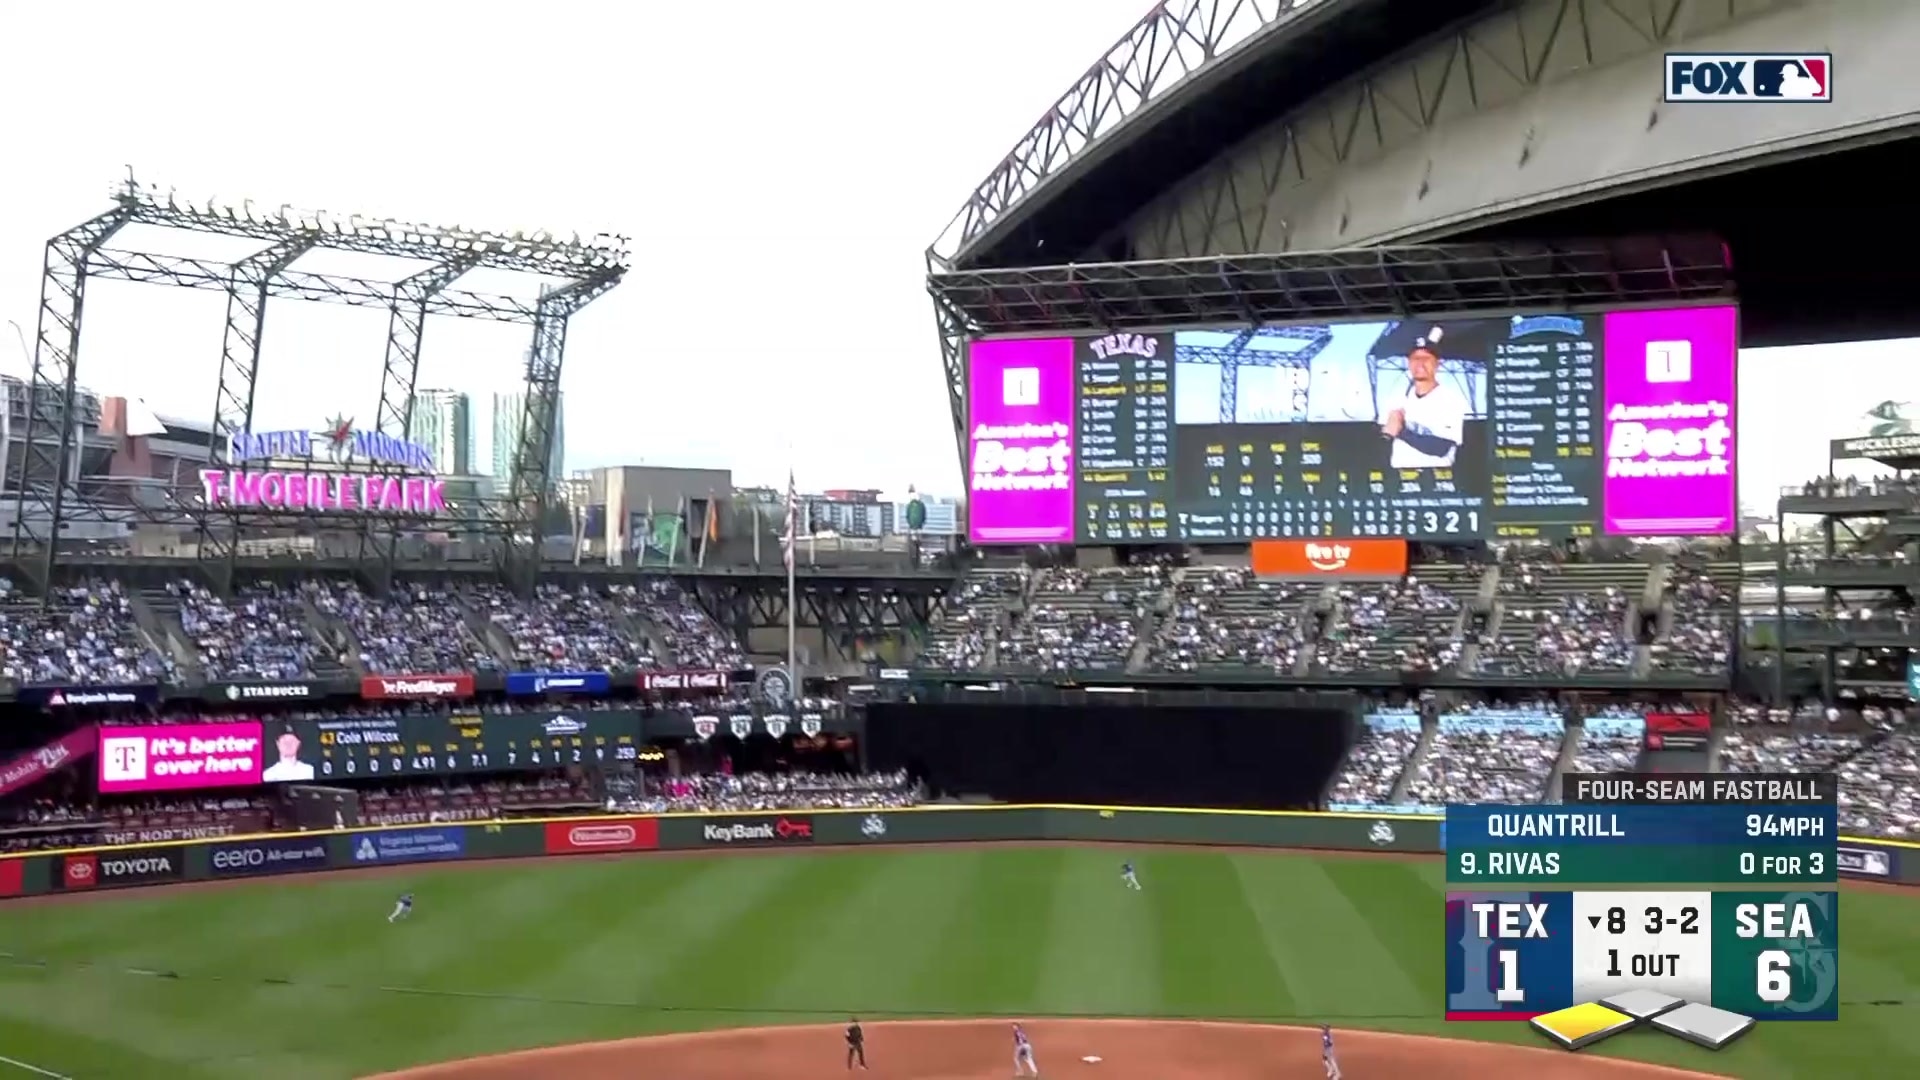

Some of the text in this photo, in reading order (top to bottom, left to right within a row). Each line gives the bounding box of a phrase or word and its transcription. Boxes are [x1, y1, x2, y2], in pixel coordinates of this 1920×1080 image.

[1089, 333, 1158, 359] TEXAS
[229, 430, 311, 462] SEATTLE
[1607, 419, 1731, 458] Best
[355, 428, 437, 475] MARINERS
[973, 439, 1071, 473] Best
[200, 469, 447, 512] T-MOBILE PARK
[1423, 511, 1479, 533] 3 2 1
[652, 675, 681, 688] Coca-Cola
[689, 674, 719, 687] Coca-Cola
[242, 686, 309, 697] STARBUCKS
[151, 736, 258, 756] It's better
[336, 732, 361, 744] Cole
[363, 731, 400, 743] Wilcox
[115, 746, 136, 772] T
[154, 756, 254, 776] over here
[322, 760, 333, 774] 0
[346, 760, 356, 773] 0
[369, 759, 379, 772] 0
[392, 758, 402, 771] 0
[105, 832, 138, 844] THE
[575, 831, 631, 842] Nintendo
[704, 823, 774, 842] KeyBank
[101, 857, 172, 876] TOYOTA
[213, 848, 264, 868] eero
